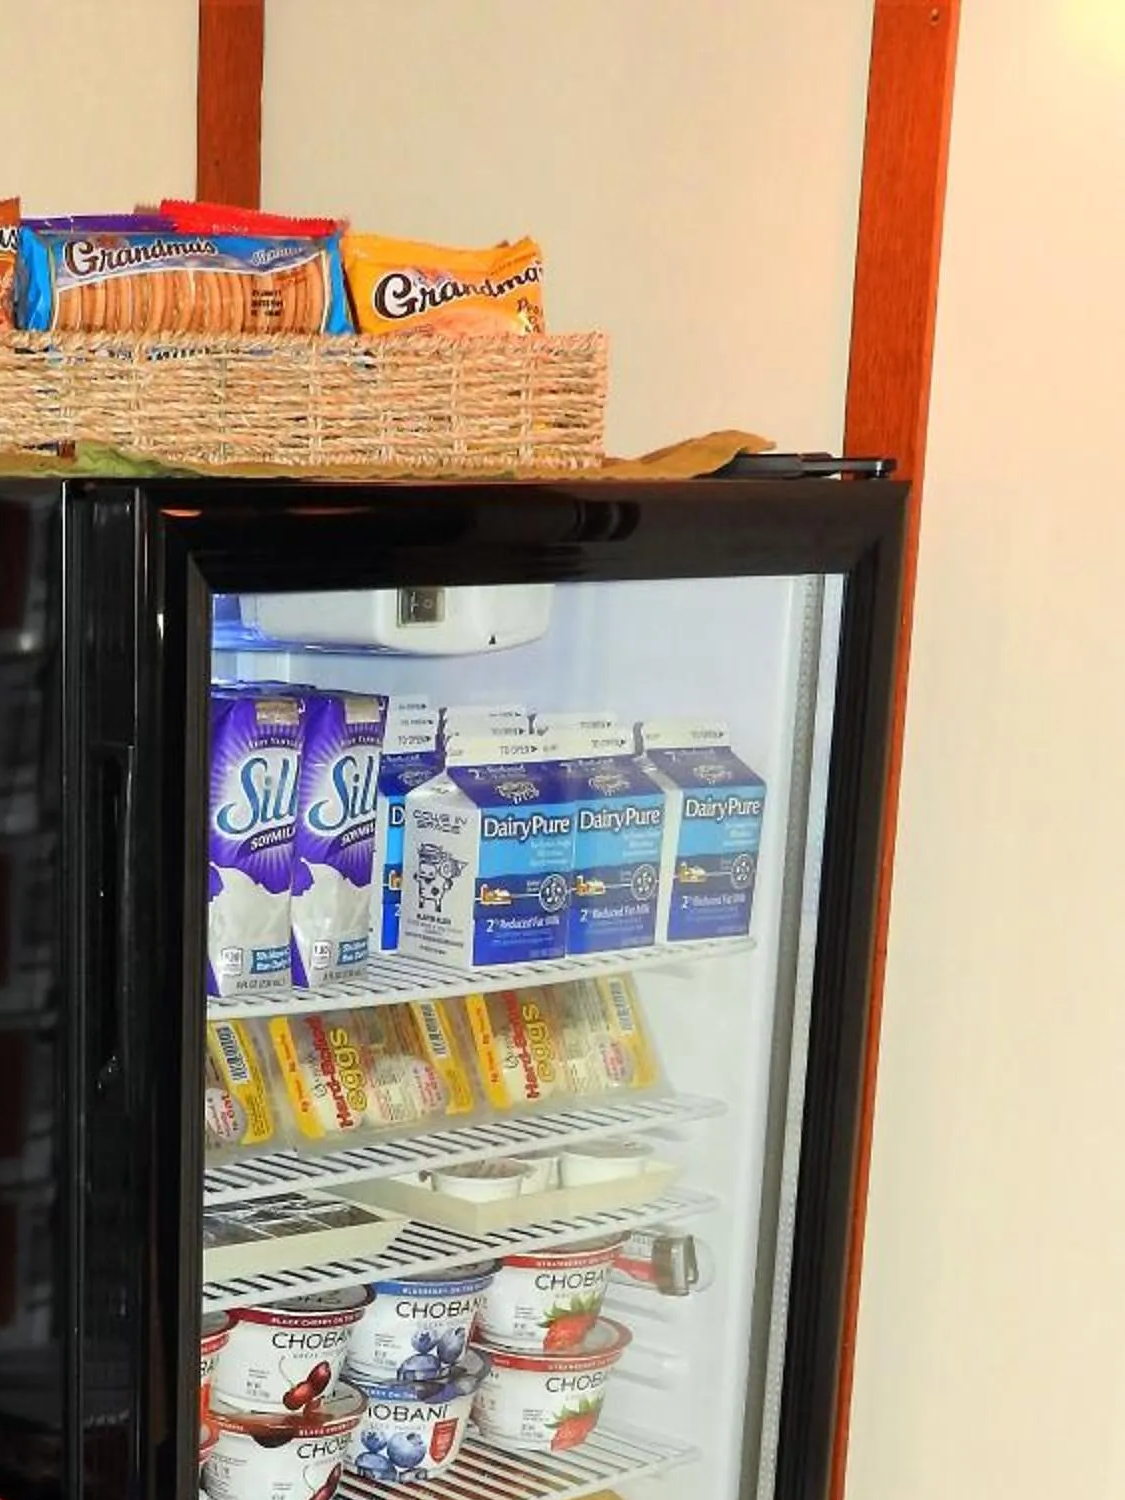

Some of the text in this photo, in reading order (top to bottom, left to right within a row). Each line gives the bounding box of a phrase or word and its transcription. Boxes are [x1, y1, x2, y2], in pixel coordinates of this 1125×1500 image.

[308, 755, 377, 831] Sil
[580, 807, 660, 832] DairyPure
[684, 797, 761, 821] DairyPure
[484, 815, 570, 841] DairyPure
[522, 1003, 554, 1083] eggs
[329, 1027, 368, 1112] eggs
[535, 1270, 605, 1291] CHOBA
[546, 1371, 608, 1393] CHOB
